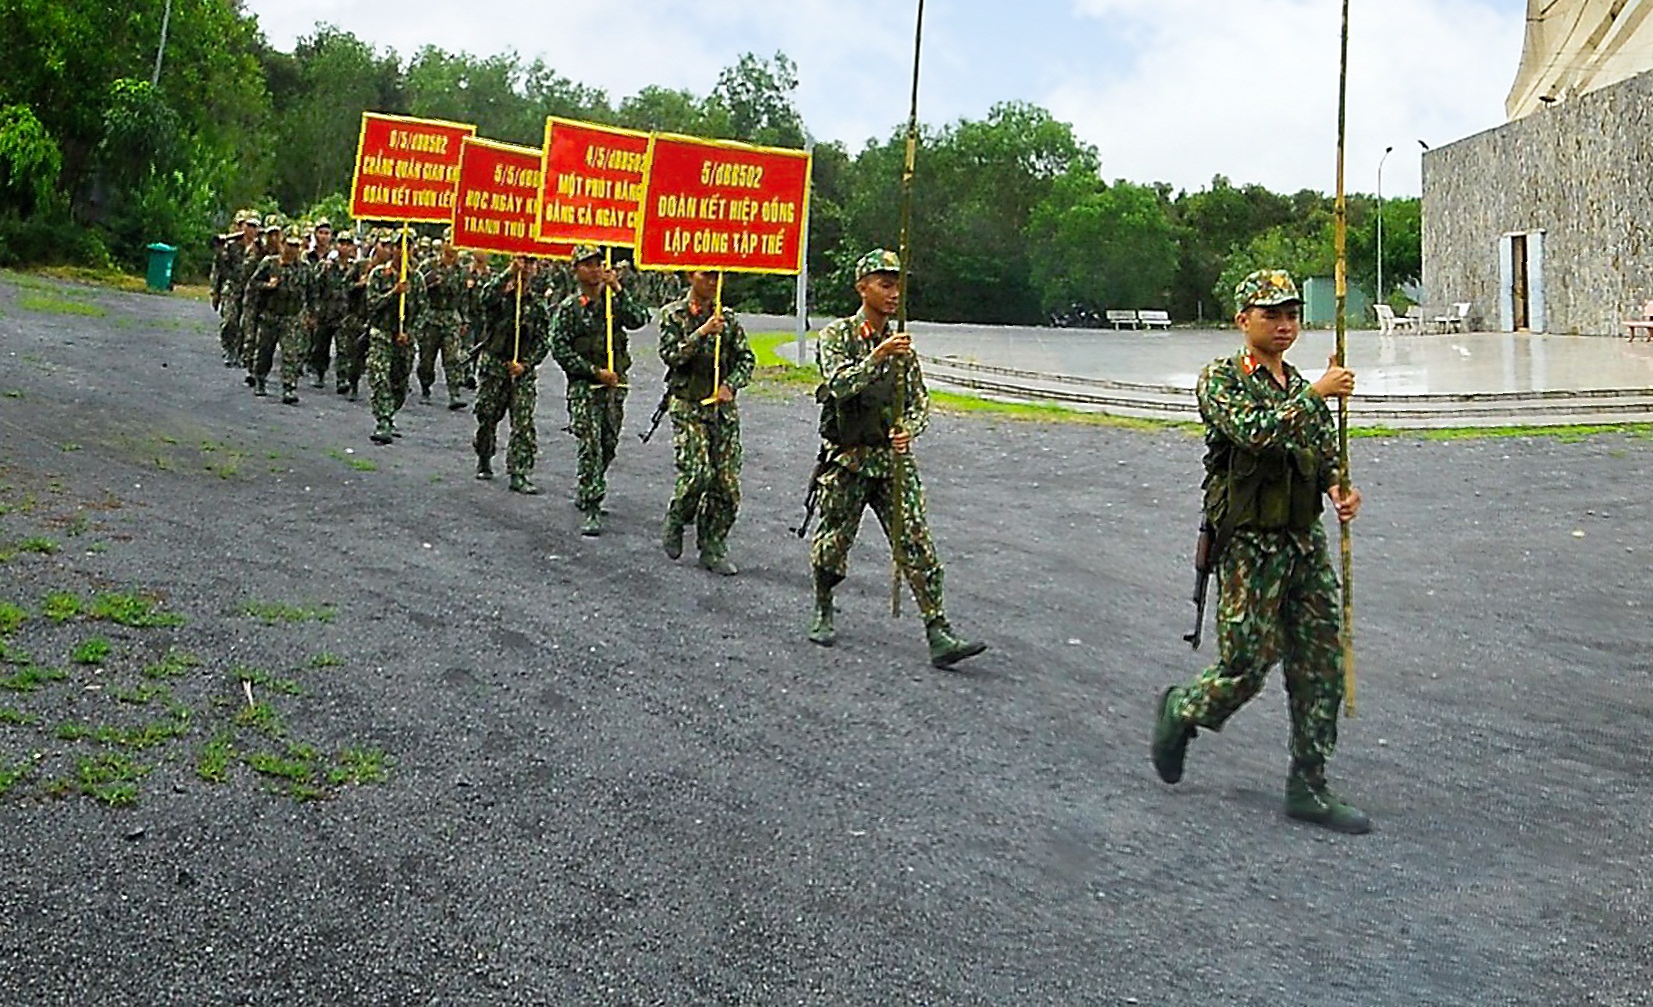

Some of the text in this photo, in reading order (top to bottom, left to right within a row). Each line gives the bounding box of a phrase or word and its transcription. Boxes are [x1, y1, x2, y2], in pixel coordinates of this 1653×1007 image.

[595, 206, 625, 227] NGÀY
[699, 193, 727, 220] KẾT
[729, 196, 759, 226] HIỆP
[664, 226, 691, 257] LẬP
[693, 228, 728, 253] CÔNG
[732, 230, 759, 259] TẬP
